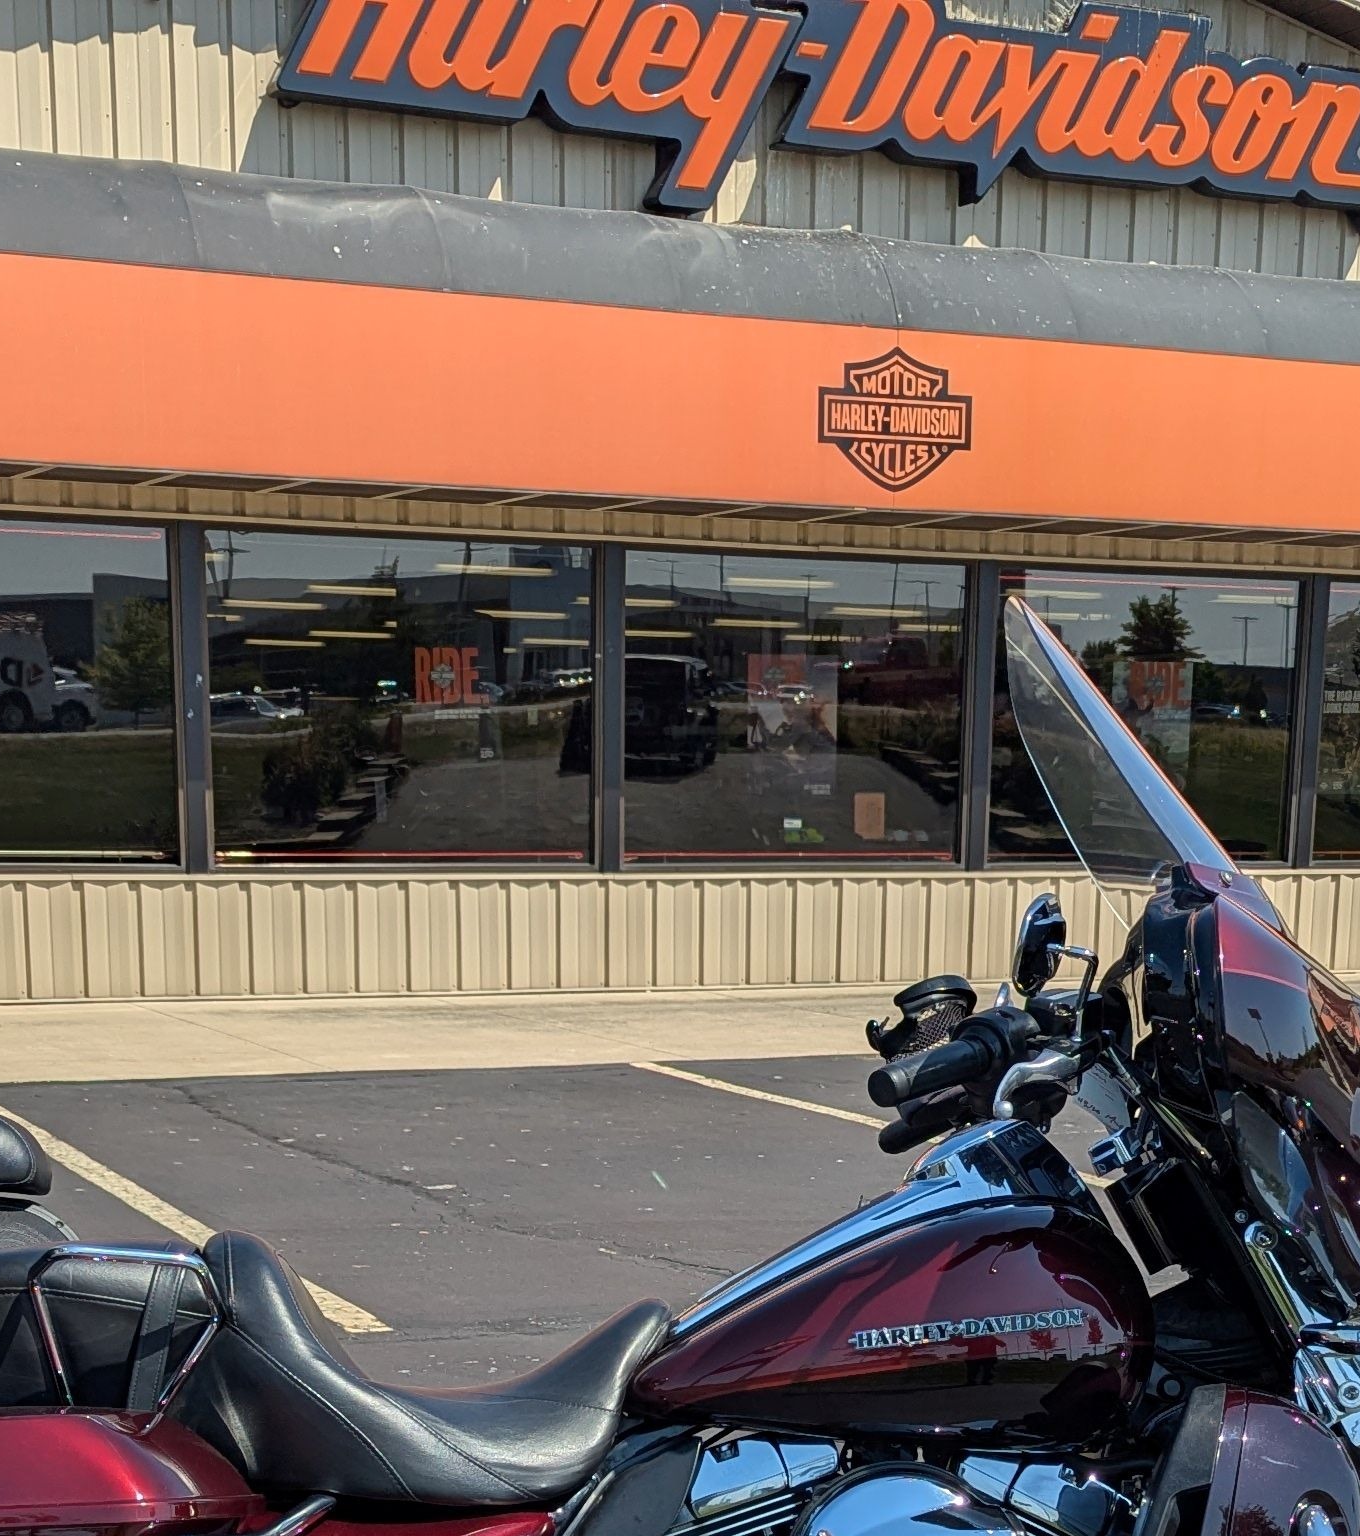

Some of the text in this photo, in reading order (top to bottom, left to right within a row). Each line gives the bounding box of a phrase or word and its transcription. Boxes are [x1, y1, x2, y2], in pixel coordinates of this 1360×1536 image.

[862, 364, 931, 398] MOTOR
[830, 402, 960, 438] HARLEY-DAVIDSON
[860, 441, 929, 479] CYCLES
